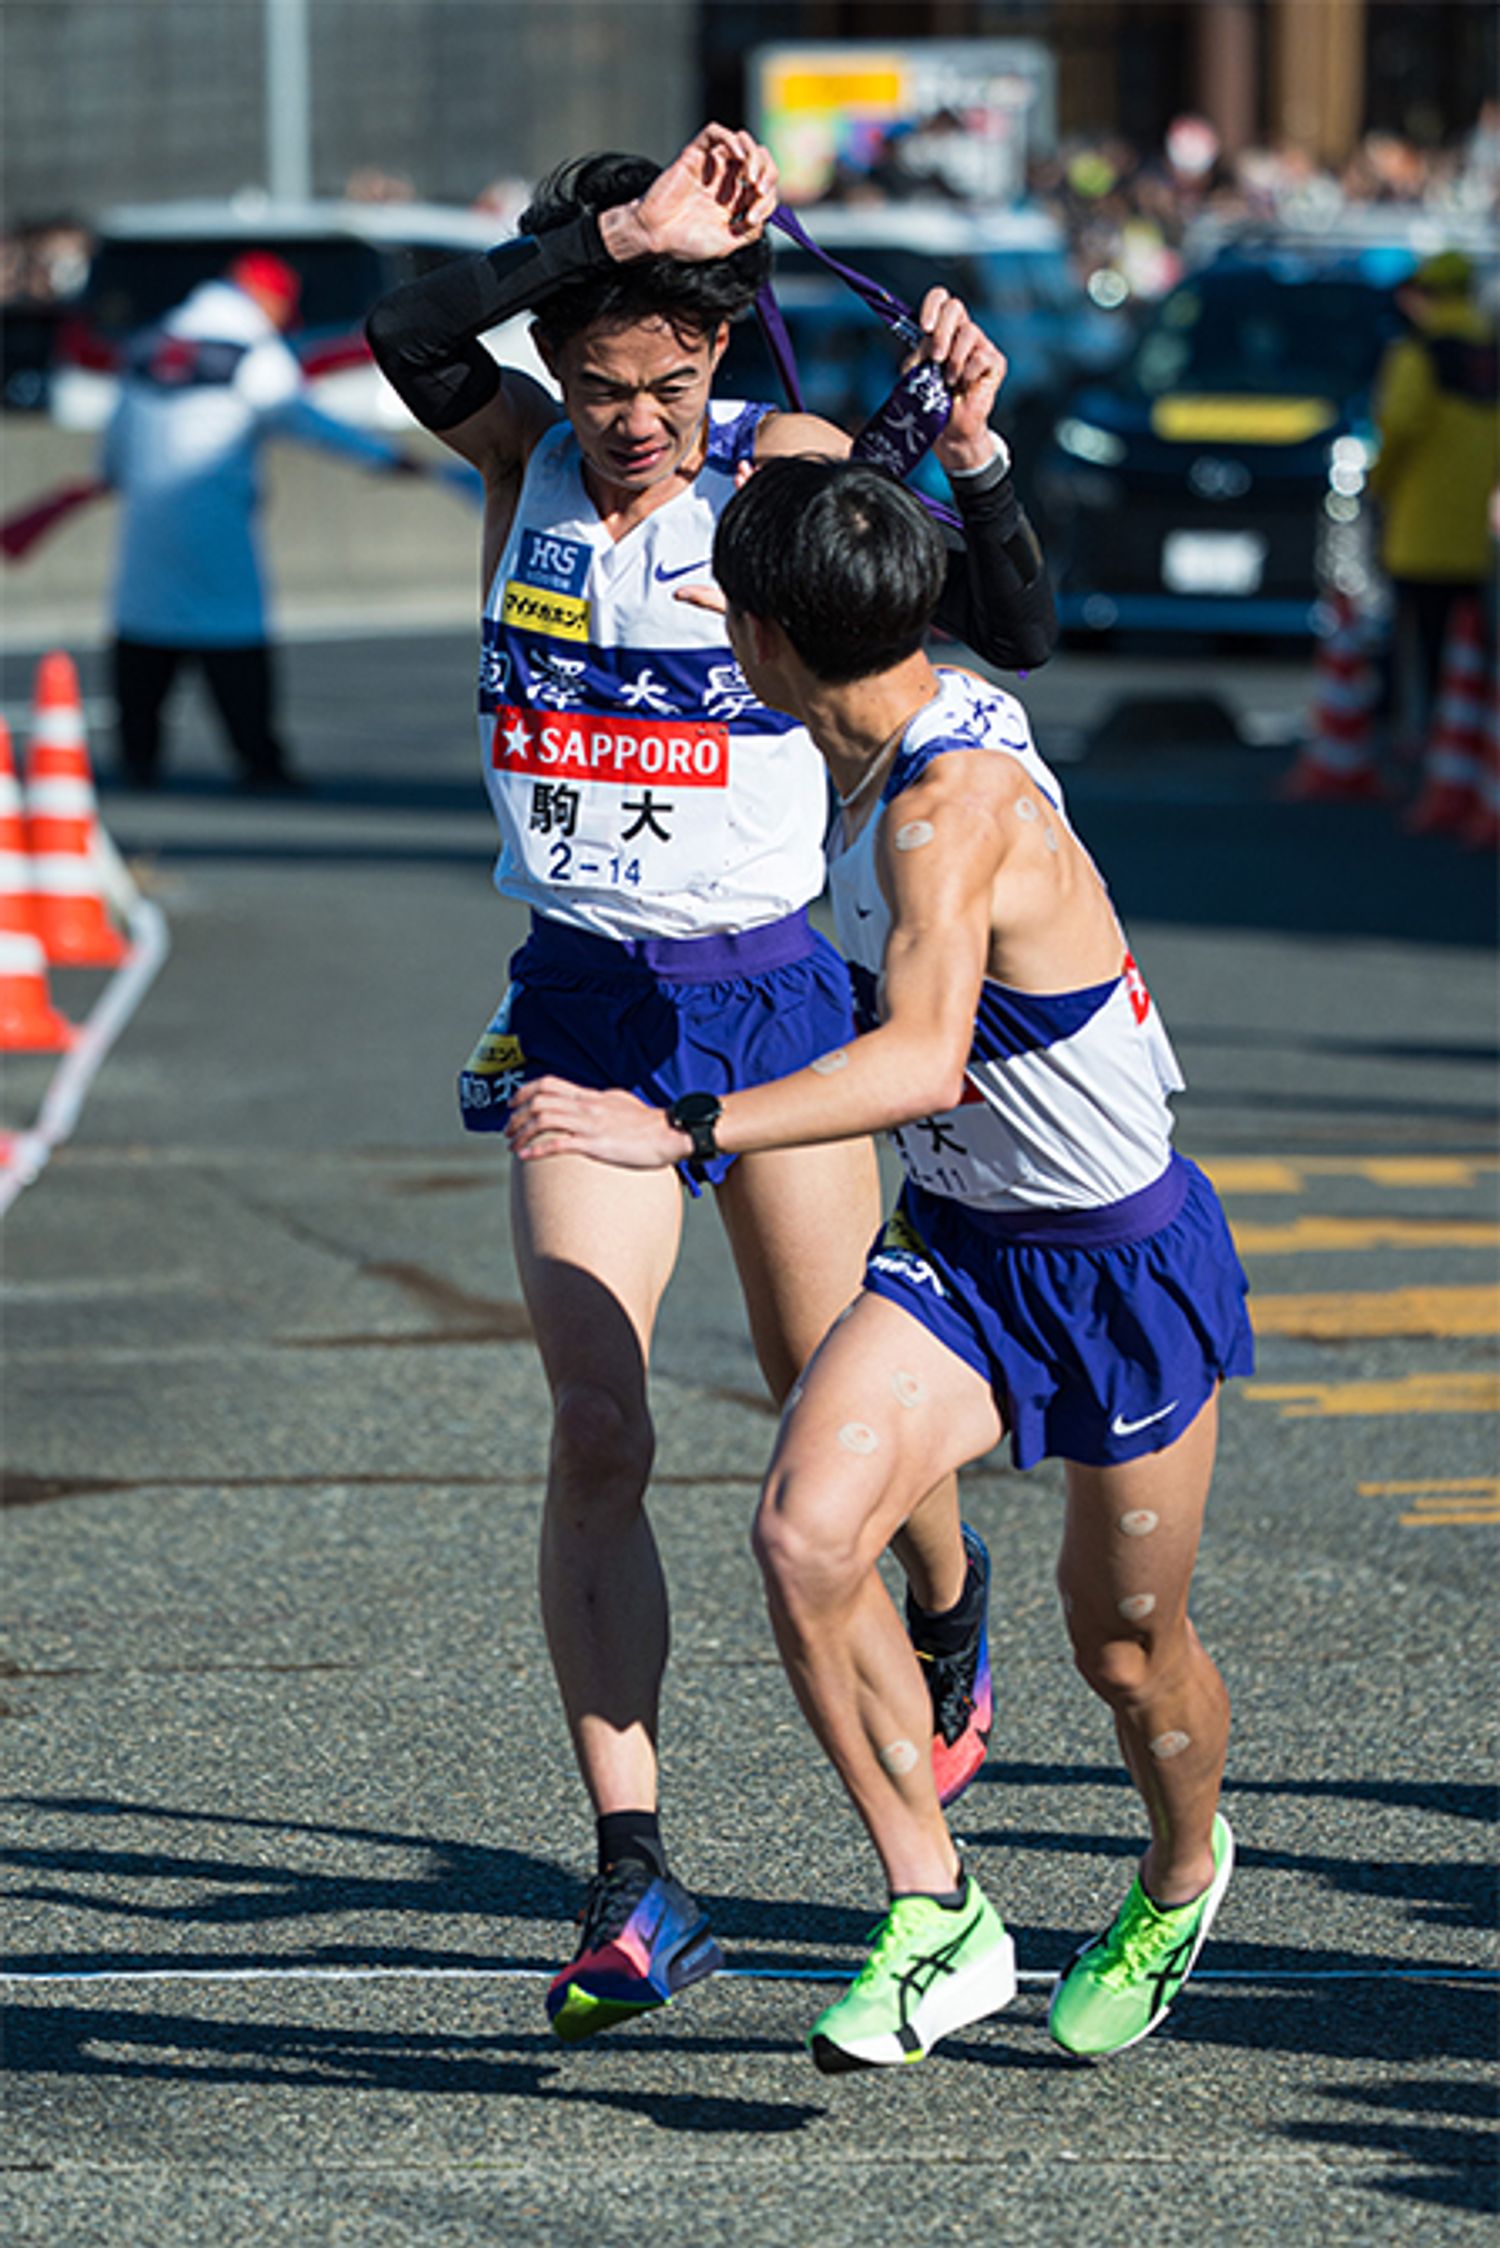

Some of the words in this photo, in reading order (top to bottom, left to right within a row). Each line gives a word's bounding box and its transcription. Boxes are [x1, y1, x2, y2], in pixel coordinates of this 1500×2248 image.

[530, 537, 579, 576] HRS
[538, 728, 720, 774] SAPPORO
[549, 841, 642, 886] 2-14
